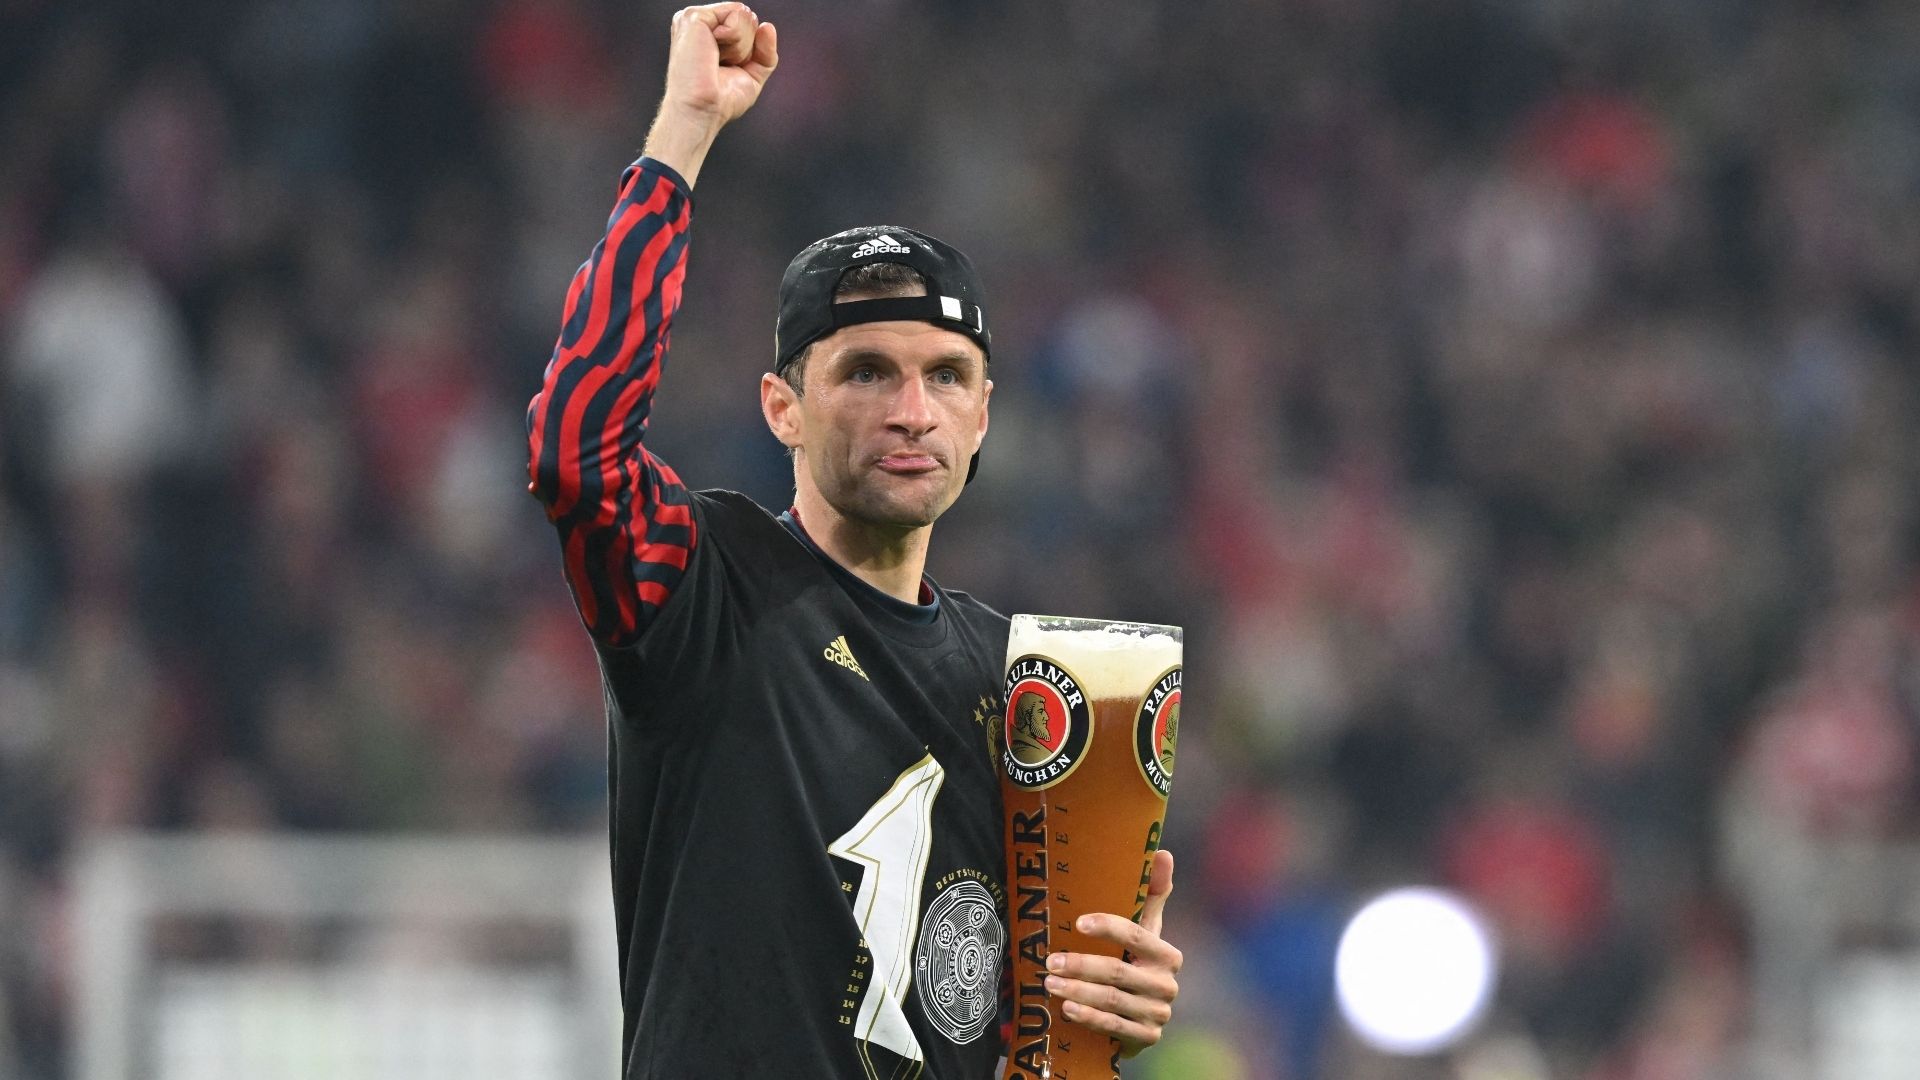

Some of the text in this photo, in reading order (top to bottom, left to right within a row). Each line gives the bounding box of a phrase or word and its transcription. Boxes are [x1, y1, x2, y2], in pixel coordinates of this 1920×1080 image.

[852, 244, 911, 259] adidas
[1003, 750, 1072, 784] MÜNCHEN
[841, 881, 853, 892] 22
[1053, 804, 1072, 1080] LKLFREI
[855, 955, 868, 965] 17
[850, 969, 864, 980] 16
[846, 983, 860, 994] 15
[842, 999, 855, 1009] 14
[838, 1015, 851, 1025] 13
